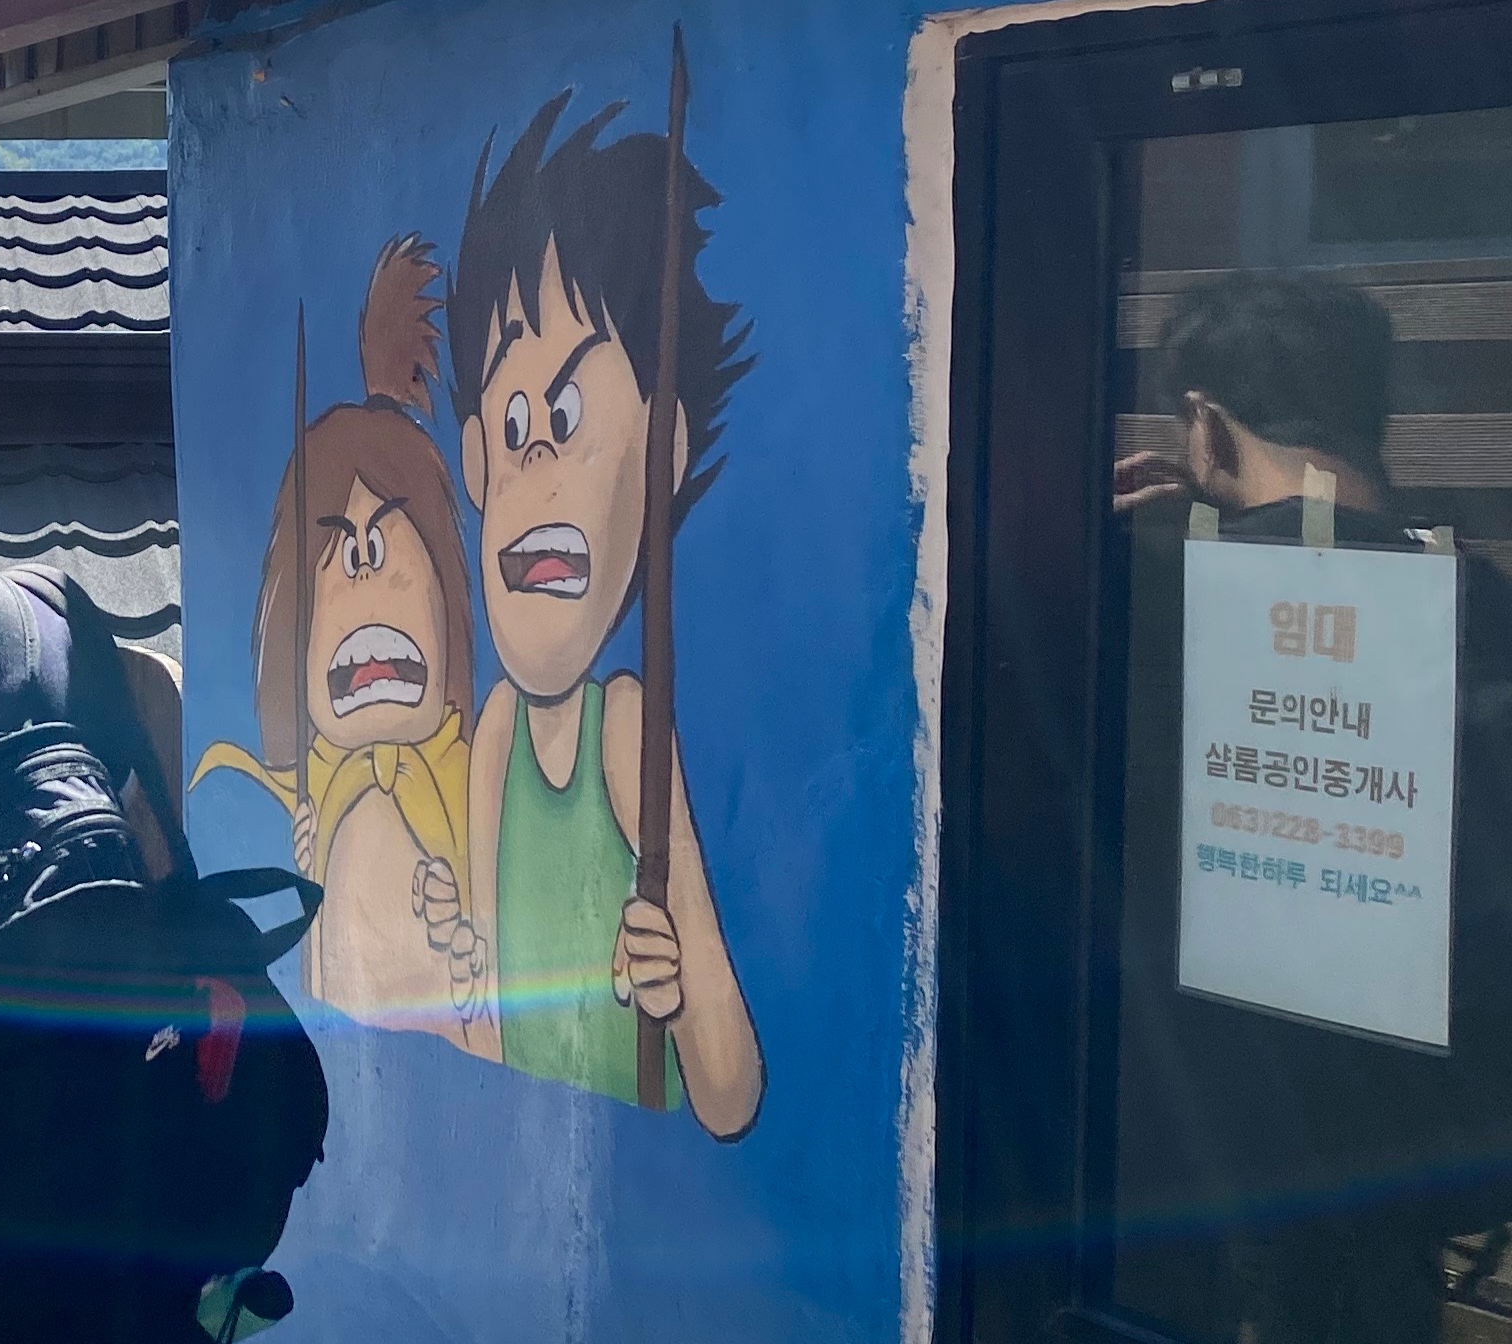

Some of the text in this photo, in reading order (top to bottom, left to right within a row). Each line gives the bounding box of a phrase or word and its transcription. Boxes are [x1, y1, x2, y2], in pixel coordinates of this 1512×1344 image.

[1270, 601, 1357, 663] 임대
[1249, 688, 1373, 740] 문의안내
[1205, 742, 1418, 809] 샬롬공인중개사
[1196, 843, 1308, 890] 행복한하루
